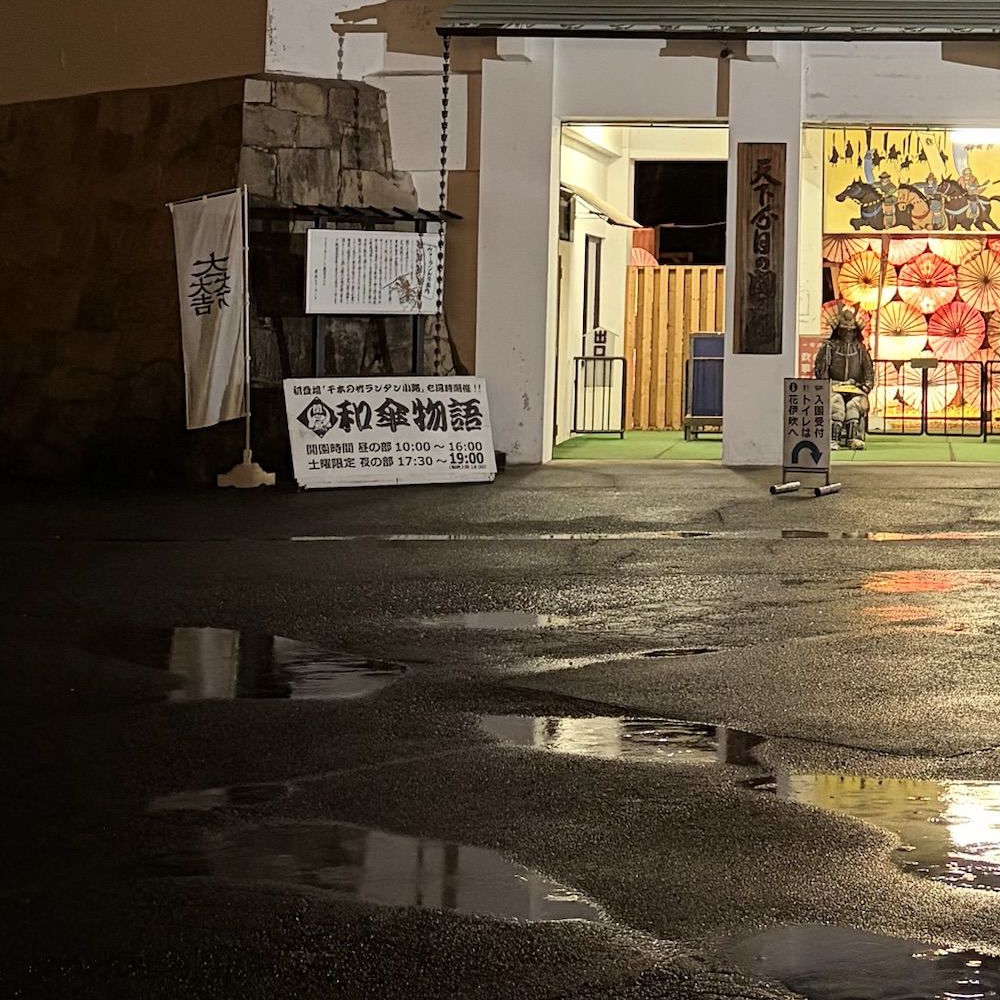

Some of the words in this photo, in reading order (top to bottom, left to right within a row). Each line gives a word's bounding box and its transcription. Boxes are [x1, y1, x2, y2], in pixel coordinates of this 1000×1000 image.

[593, 330, 607, 357] 出口
[336, 397, 484, 433] 和傘物語
[788, 394, 798, 437] 花伊吹へ
[801, 395, 811, 438] トイレは
[814, 394, 824, 438] 入園受付
[306, 443, 354, 455] 開園時間
[358, 442, 392, 453] 昼の部
[395, 441, 431, 452] 10:00
[449, 441, 482, 452] 16:00
[308, 457, 356, 470] 土曜限定
[360, 456, 394, 468] 夜の部
[398, 456, 433, 467] 17:30
[449, 452, 484, 464] 19:00
